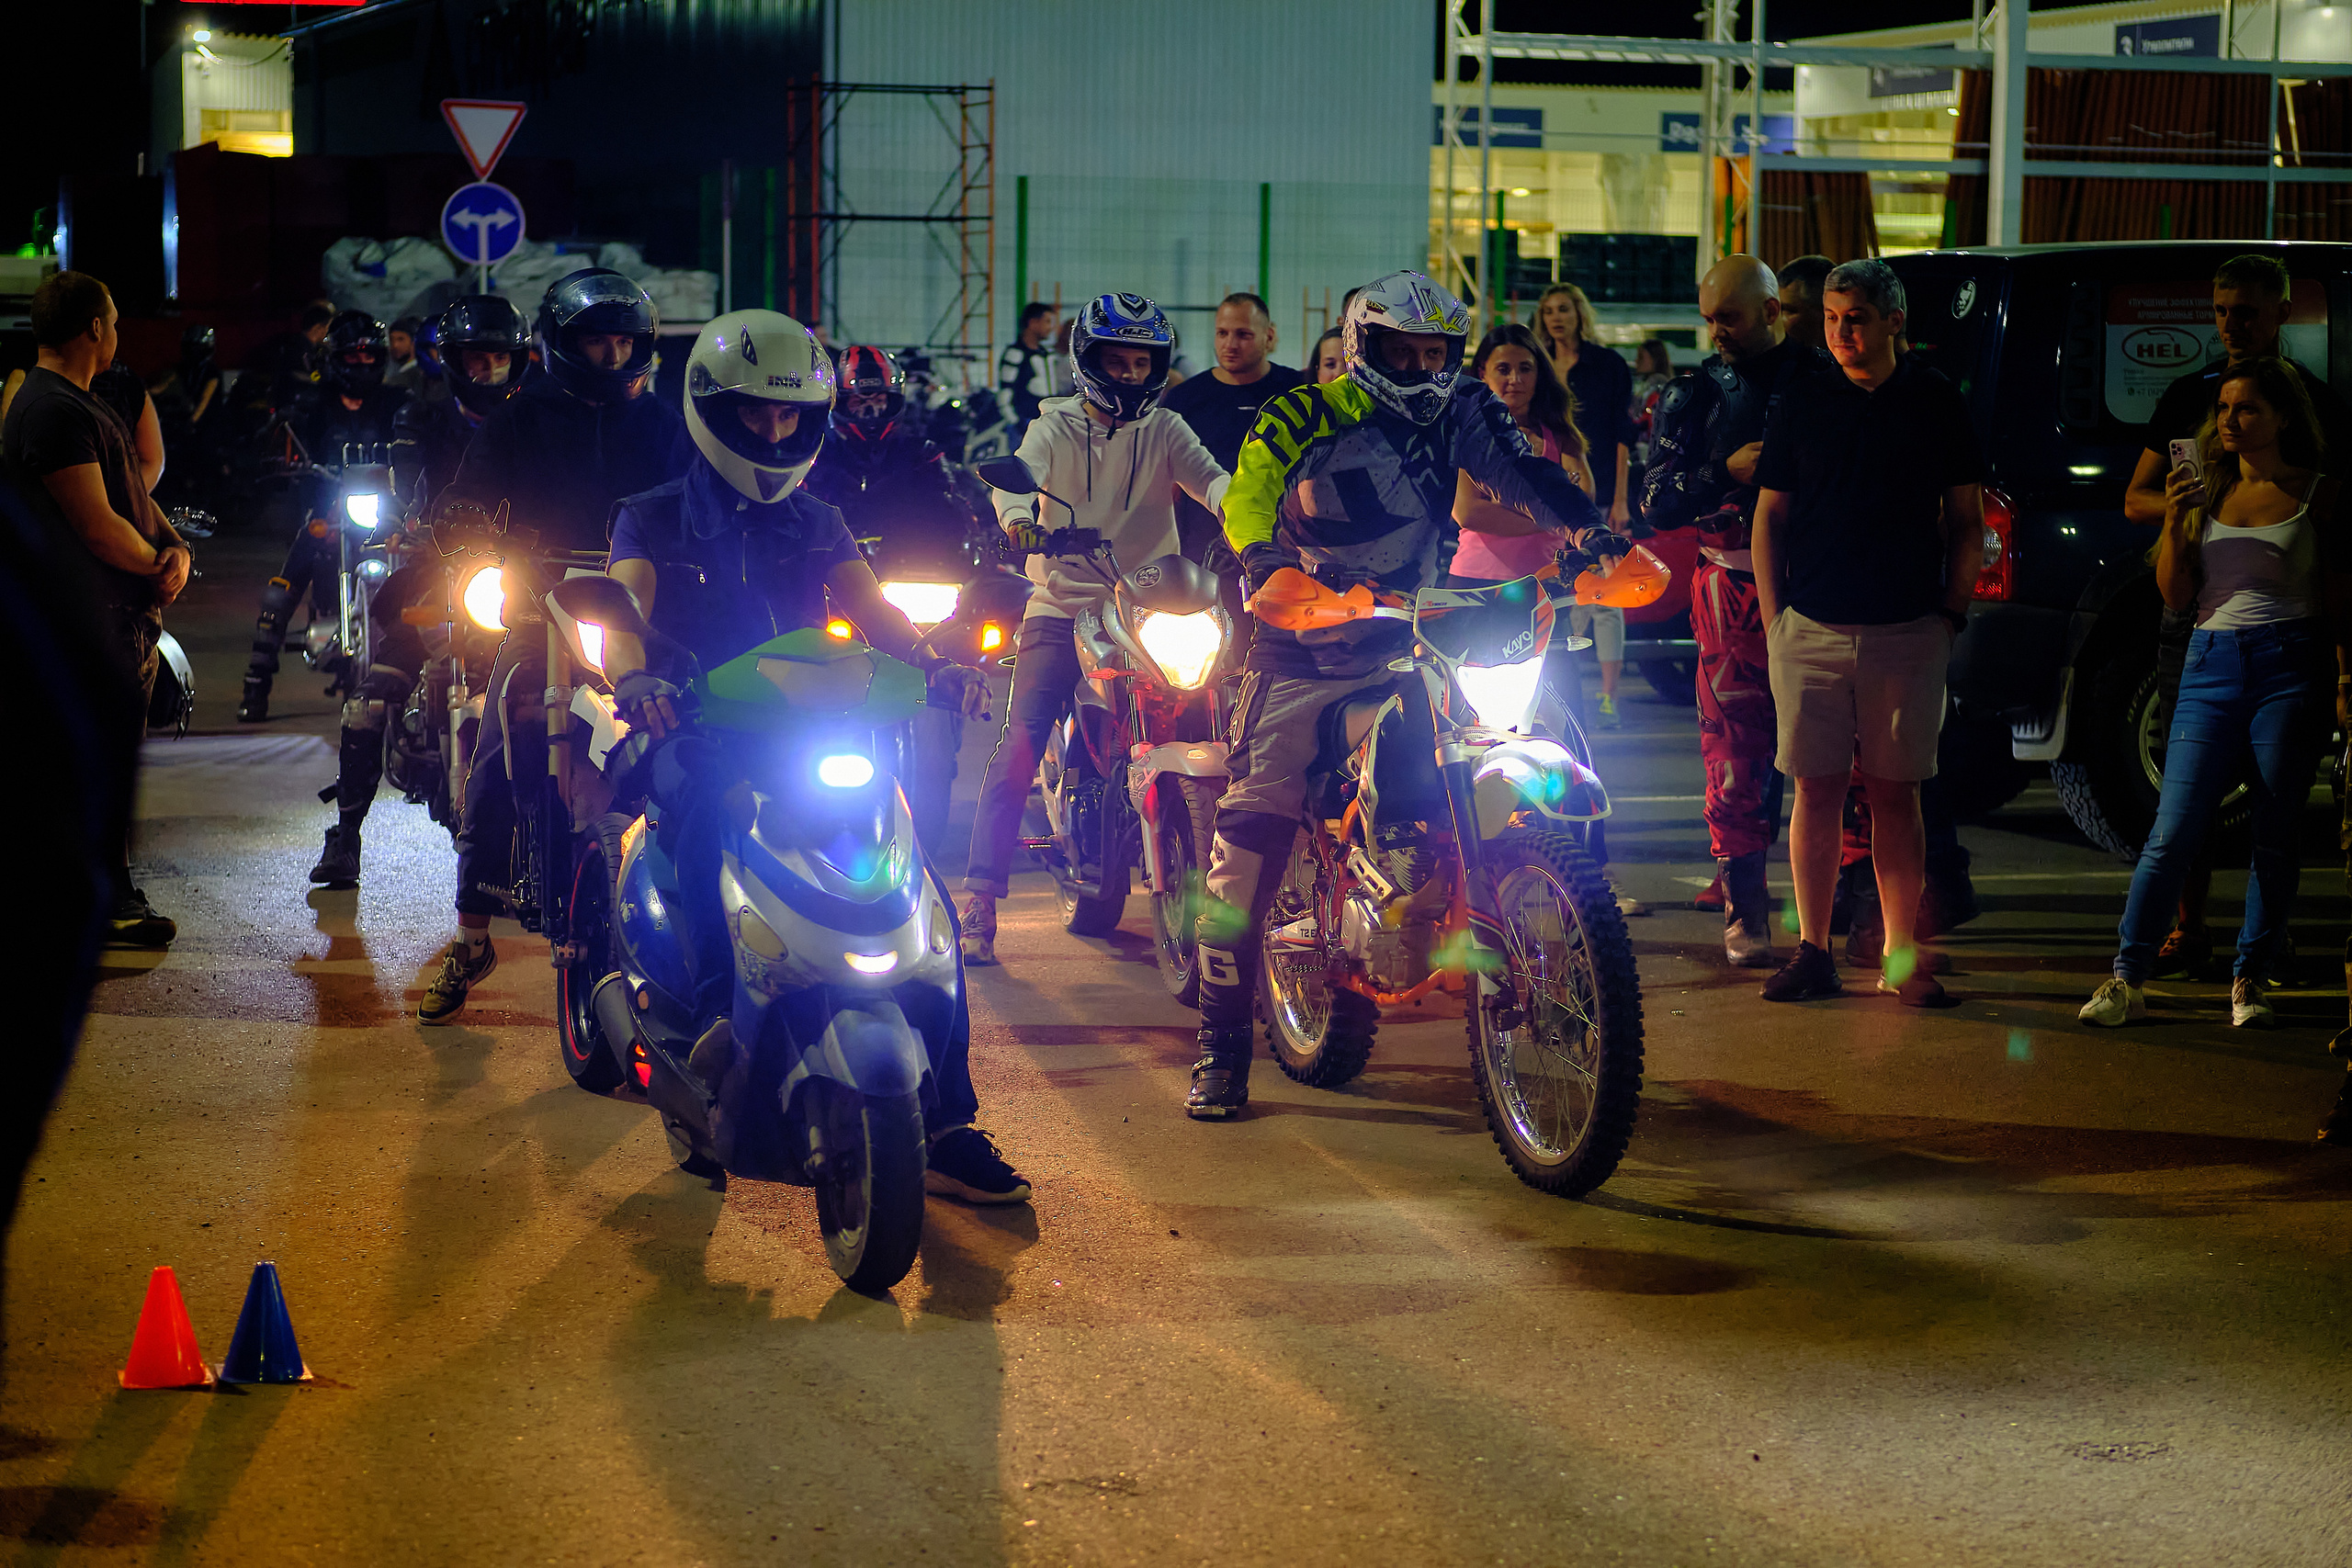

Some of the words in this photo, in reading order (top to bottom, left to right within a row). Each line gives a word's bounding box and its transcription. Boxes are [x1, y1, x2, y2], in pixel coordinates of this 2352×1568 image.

[2169, 298, 2215, 307] ЭФФЕКТИВН
[2195, 310, 2216, 320] ТОРМ
[2136, 344, 2188, 358] HEL
[1501, 630, 1532, 660] KAYO
[1300, 928, 1309, 938] T2
